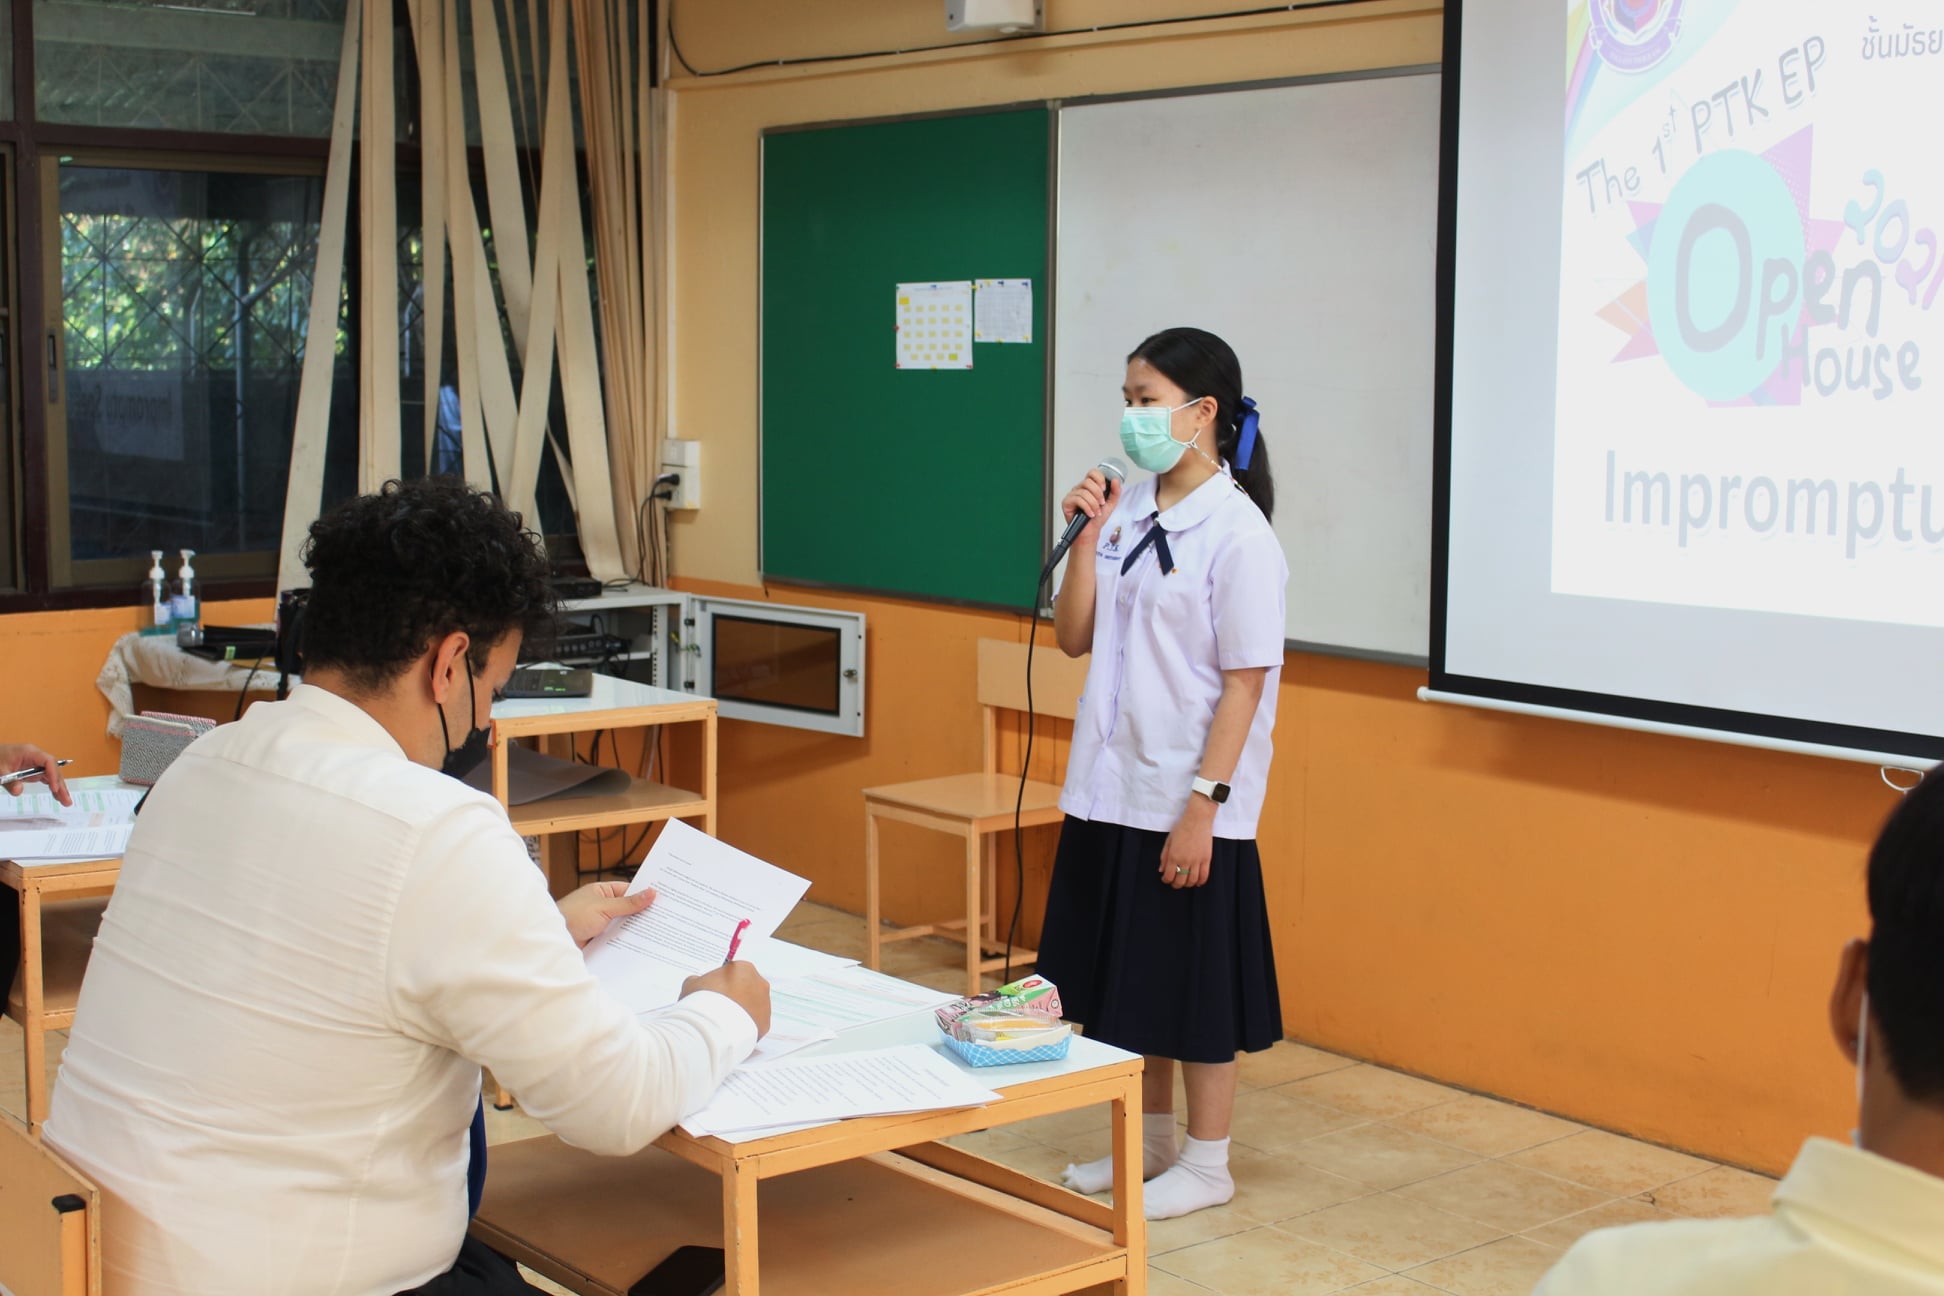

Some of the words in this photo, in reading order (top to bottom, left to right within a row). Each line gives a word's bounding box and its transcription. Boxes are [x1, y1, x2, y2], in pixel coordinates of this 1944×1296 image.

[1576, 158, 1641, 214] The
[1652, 104, 1678, 174] 1st
[1691, 68, 1769, 154] PTK
[1779, 36, 1826, 105] EP
[1675, 202, 1882, 361] Open
[1780, 323, 1922, 401] House
